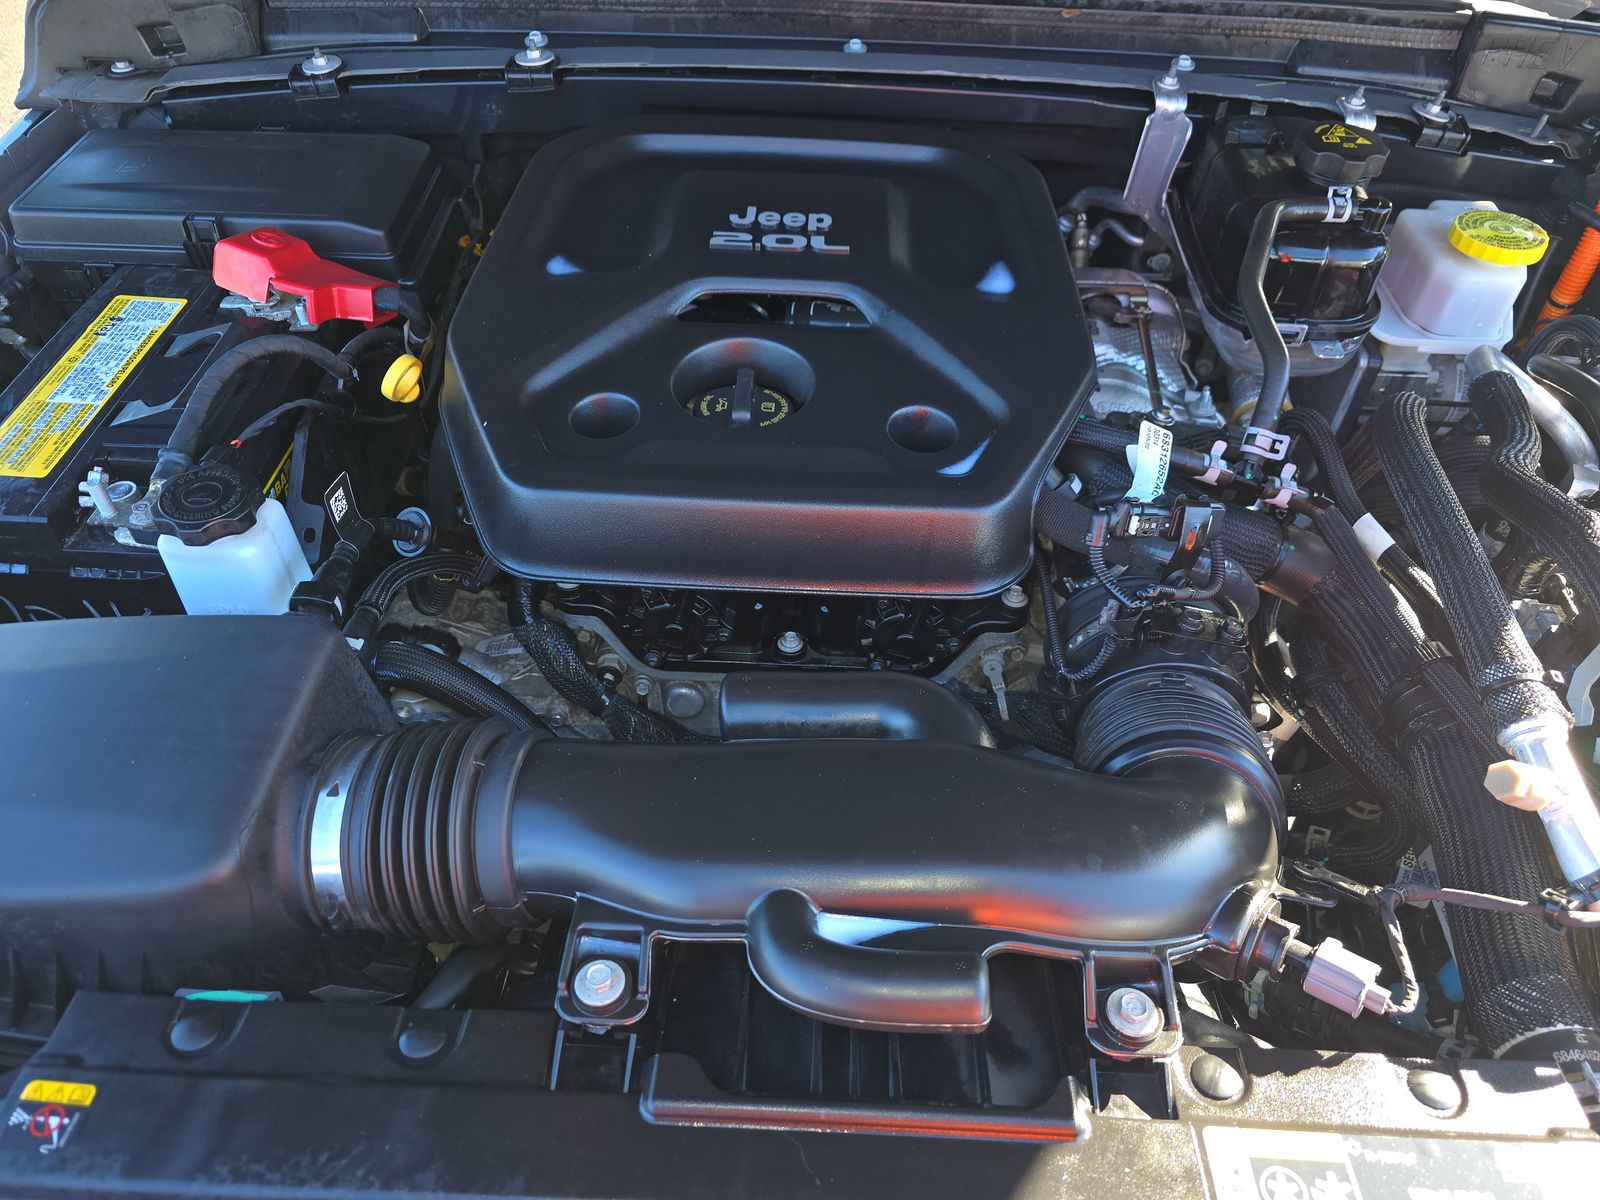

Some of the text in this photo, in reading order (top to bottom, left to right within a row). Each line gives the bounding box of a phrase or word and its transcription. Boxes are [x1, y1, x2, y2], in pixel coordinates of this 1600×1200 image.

[728, 206, 833, 232] Jeep
[709, 231, 850, 255] 2.0L
[1151, 432, 1171, 497] 68312652AC
